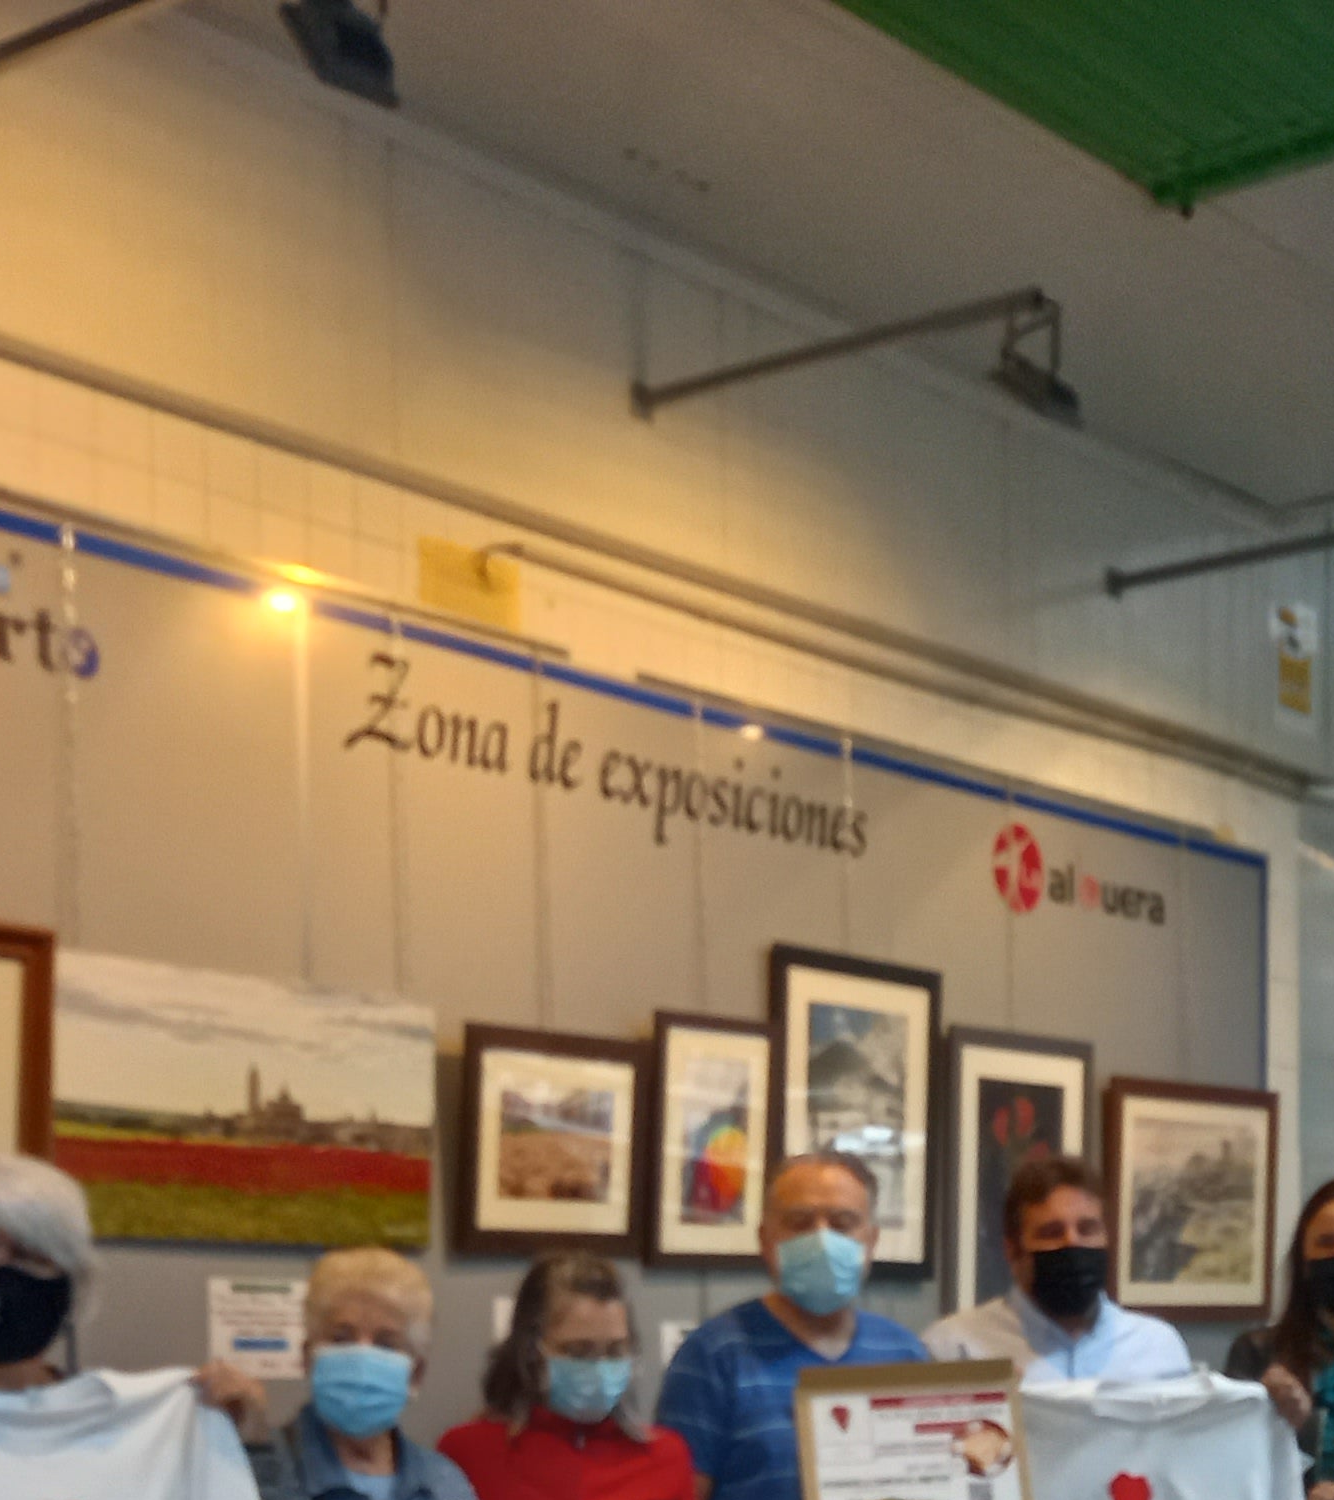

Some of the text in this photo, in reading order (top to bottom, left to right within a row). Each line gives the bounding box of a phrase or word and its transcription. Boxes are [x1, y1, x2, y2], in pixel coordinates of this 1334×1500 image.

[344, 651, 868, 858] Zona de exposiciones
